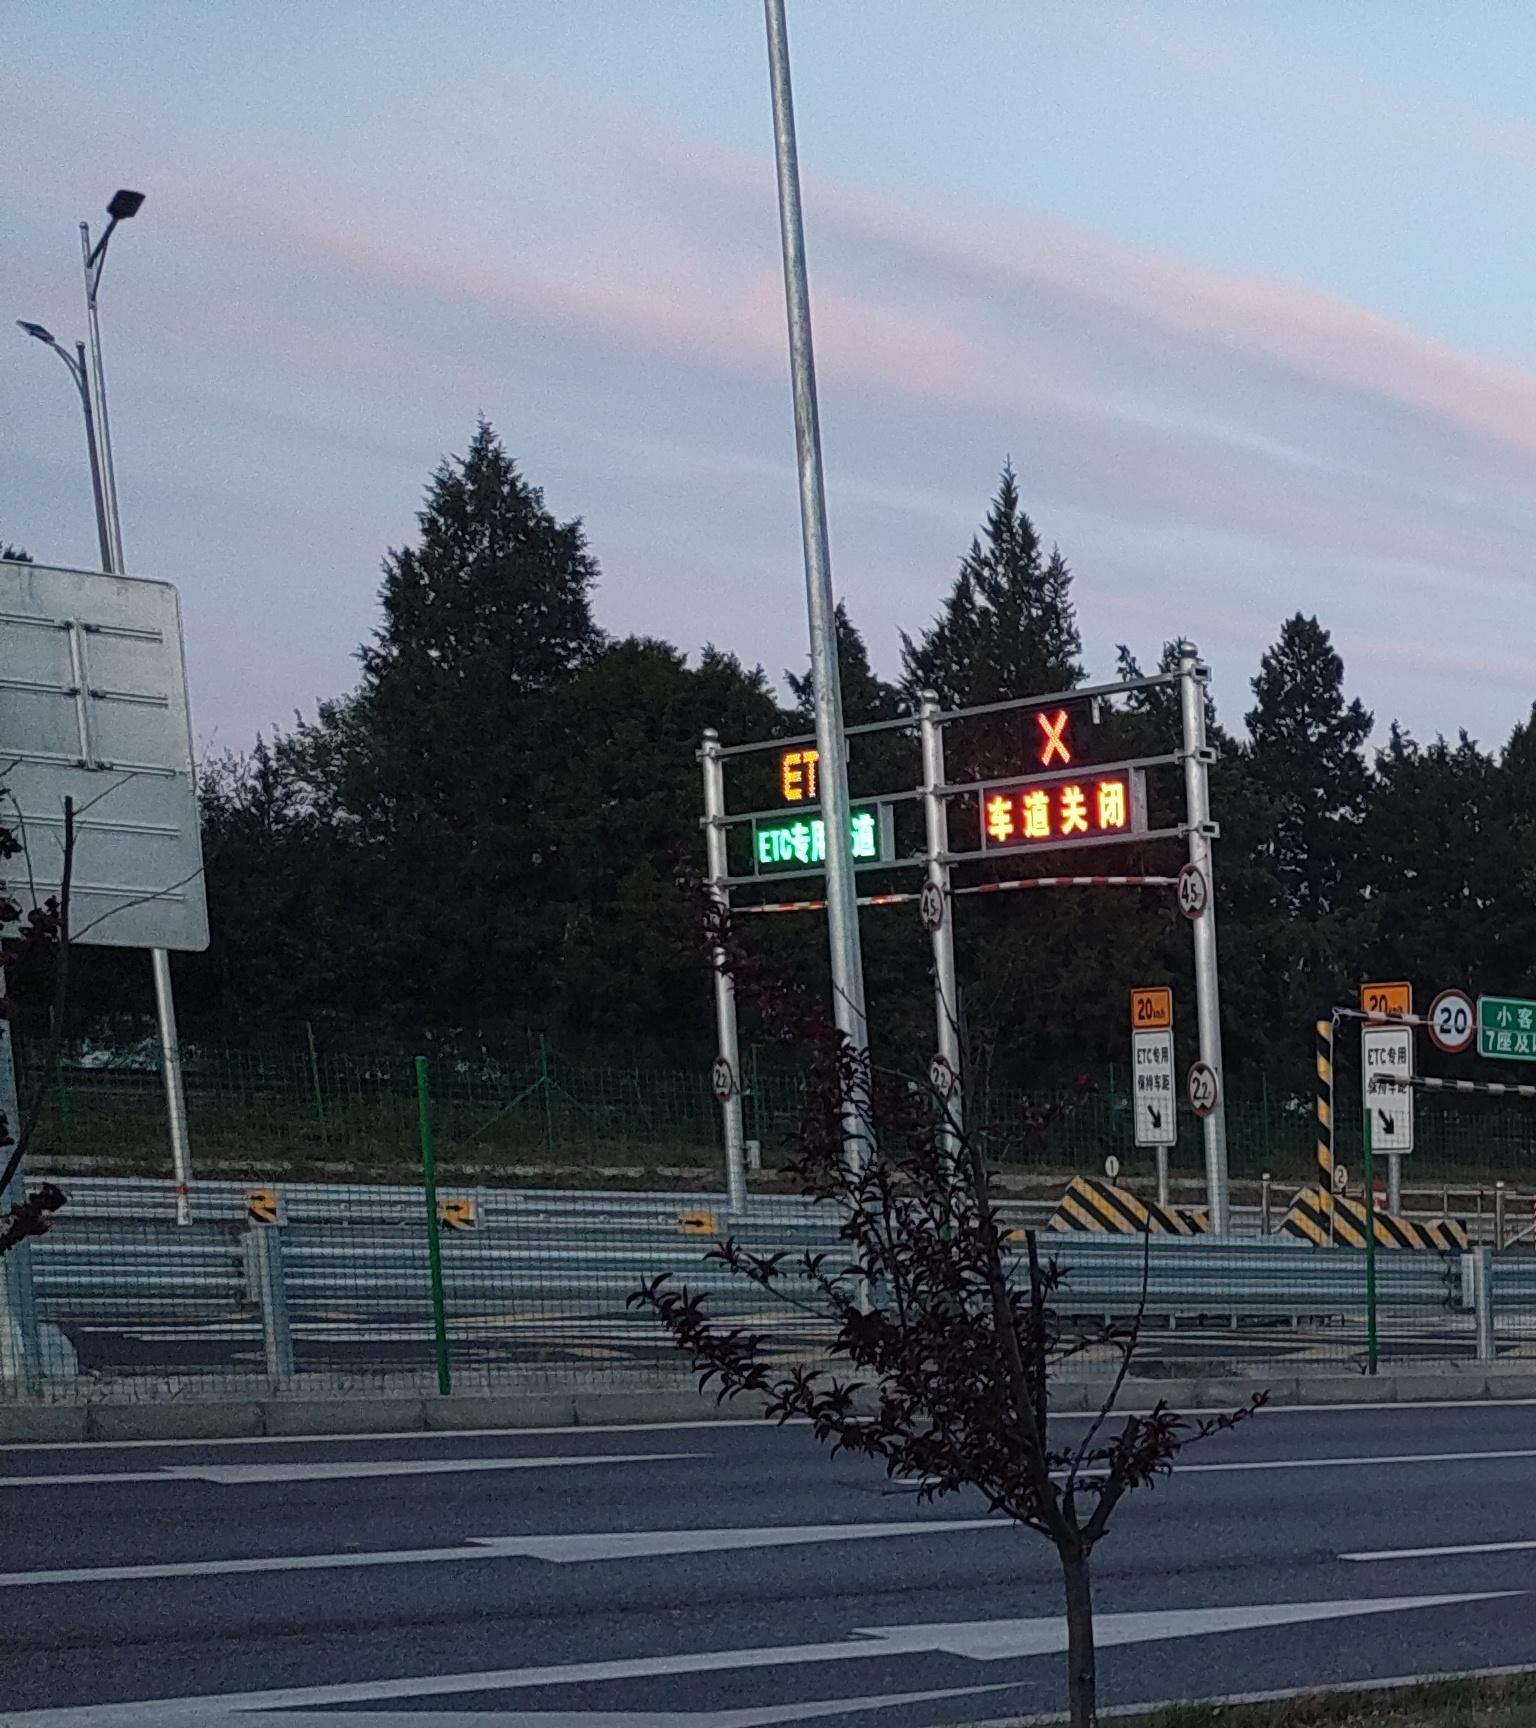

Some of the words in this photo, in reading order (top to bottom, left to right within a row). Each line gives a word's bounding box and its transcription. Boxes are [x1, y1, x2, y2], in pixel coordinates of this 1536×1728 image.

[783, 751, 820, 801] ET
[987, 781, 1125, 842] 车道关闭
[758, 813, 875, 863] ETC专用道
[1439, 1008, 1467, 1035] 20
[1137, 1046, 1169, 1065] ETC专用
[1367, 1046, 1407, 1065] ETC专用
